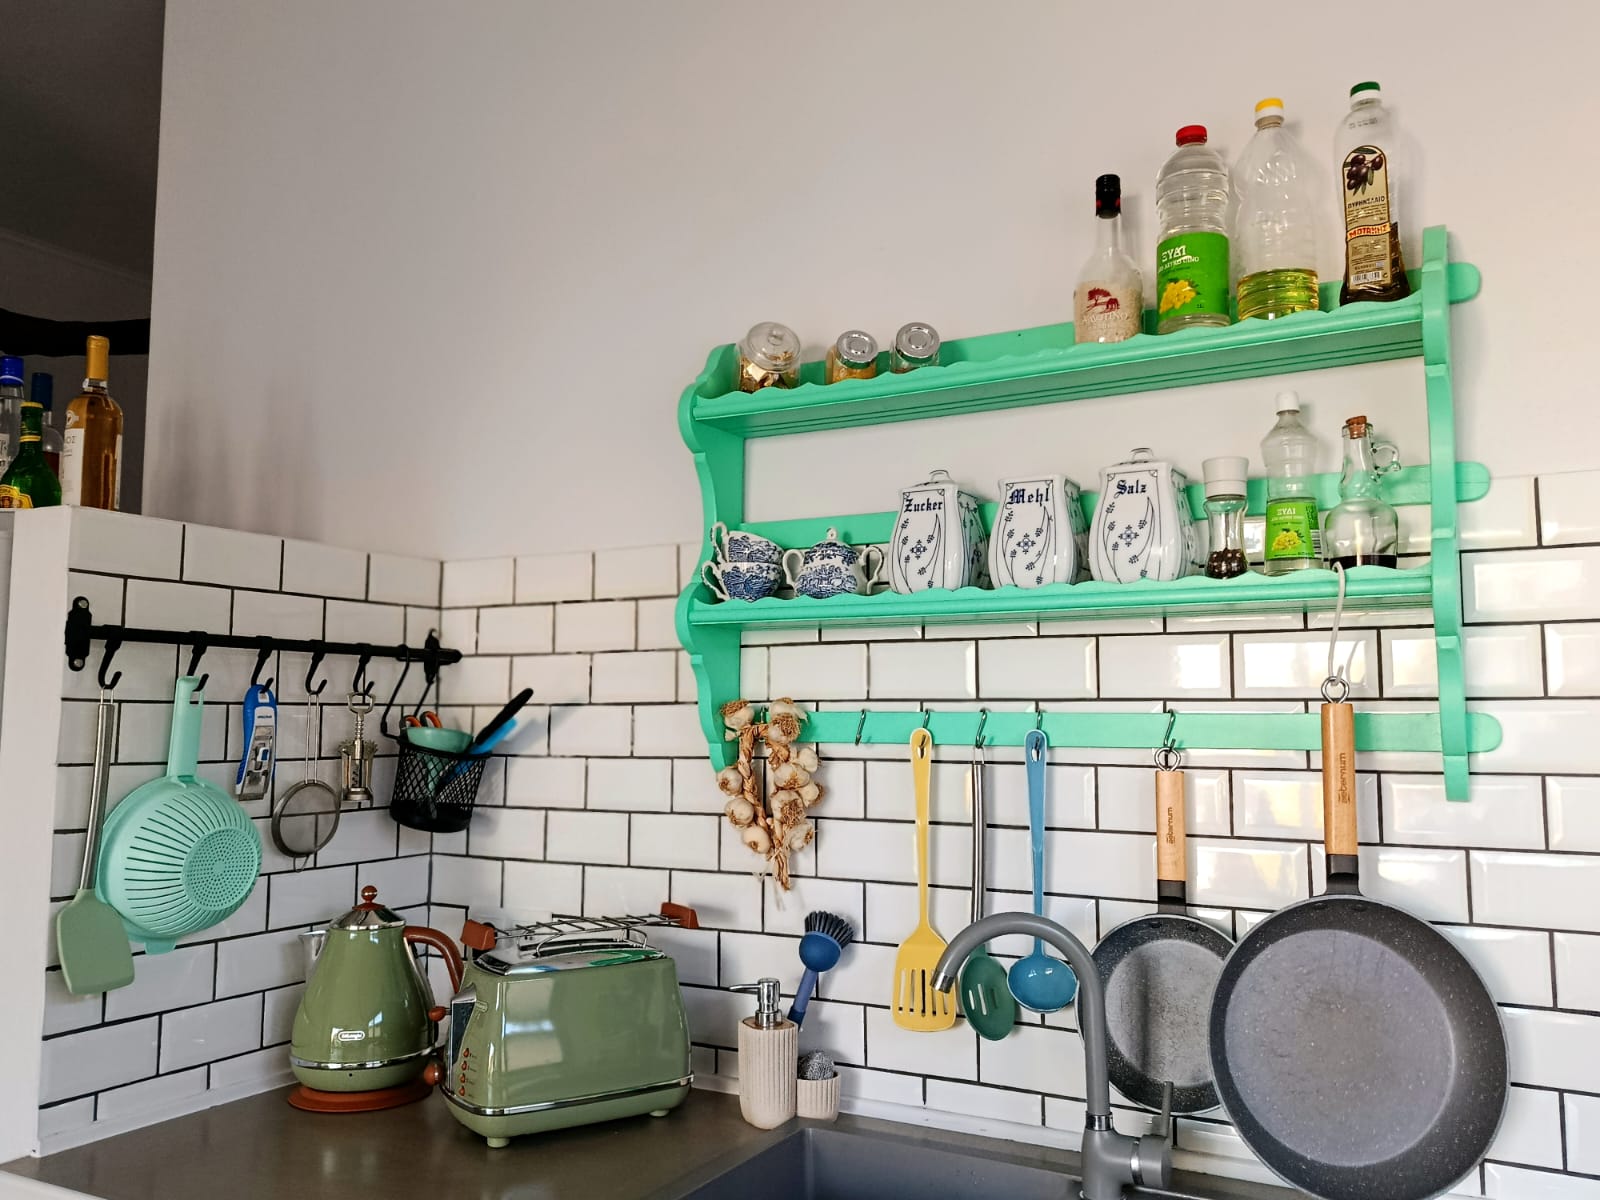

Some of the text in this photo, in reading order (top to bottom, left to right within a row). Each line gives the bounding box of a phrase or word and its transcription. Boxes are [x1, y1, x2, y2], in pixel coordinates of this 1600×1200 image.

[1006, 487, 1050, 509] Mehl
[1114, 479, 1148, 498] Salz
[904, 498, 943, 513] Zucker
